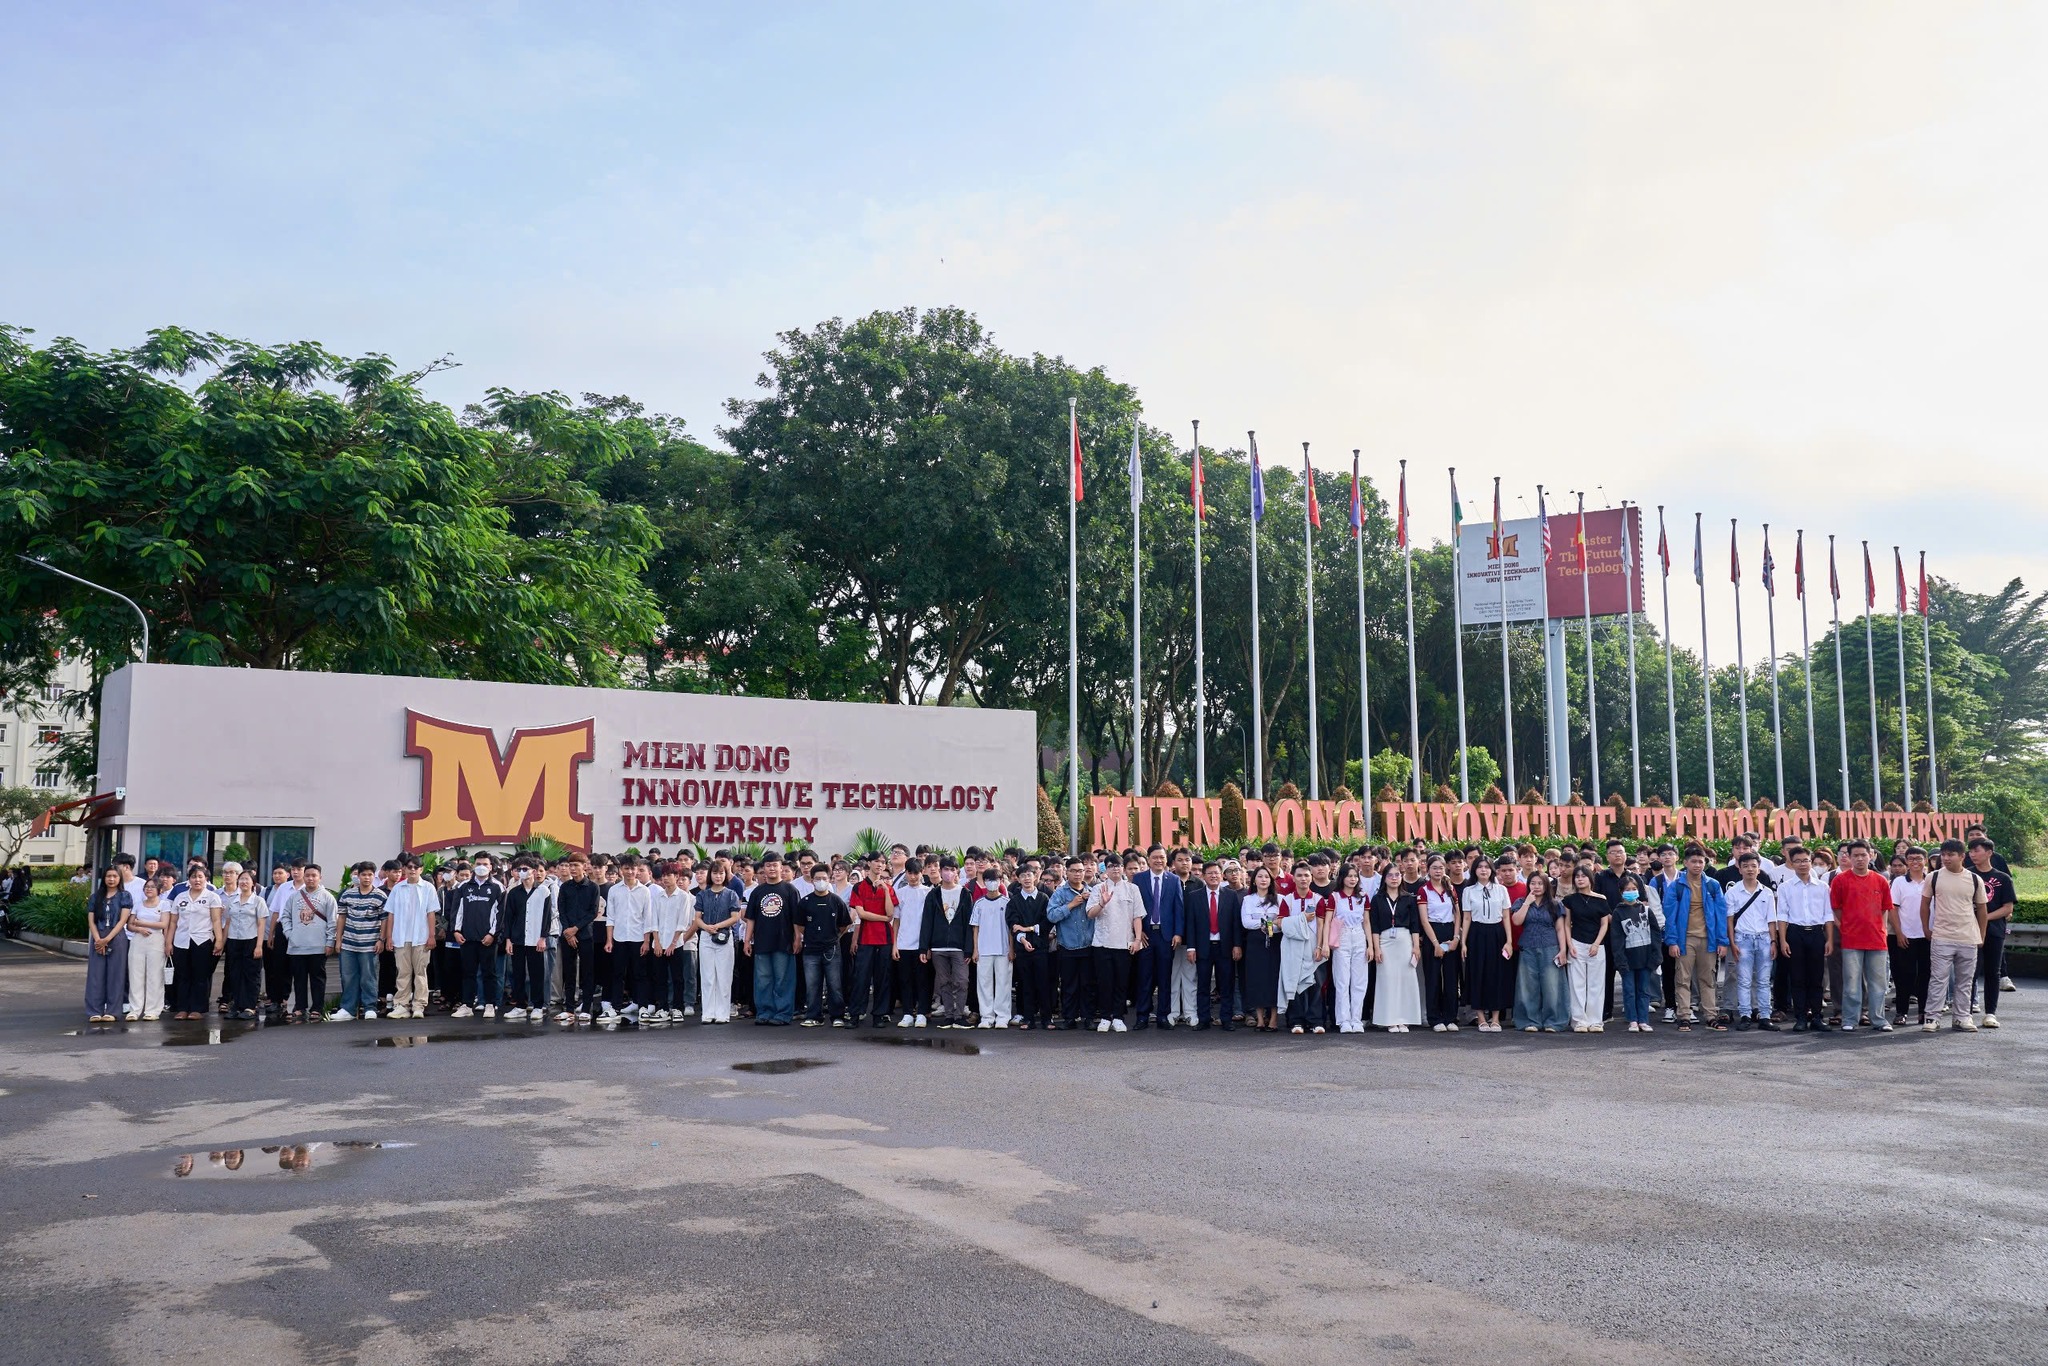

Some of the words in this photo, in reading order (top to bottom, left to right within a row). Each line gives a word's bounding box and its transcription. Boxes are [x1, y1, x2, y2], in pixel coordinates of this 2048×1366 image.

[1486, 575, 1522, 583] UNIVRSITY
[623, 741, 706, 771] MIEN
[714, 744, 790, 773] DONG
[622, 777, 813, 809] INNOVATIVE
[821, 782, 998, 812] TECHNOLOGY
[622, 815, 818, 844] UNIVERSITY
[1088, 795, 1222, 853] MIEN
[1242, 798, 1366, 845] DONG
[1379, 801, 1616, 843] INNOVATIVE
[1629, 807, 1828, 842] TECHNOLOGY
